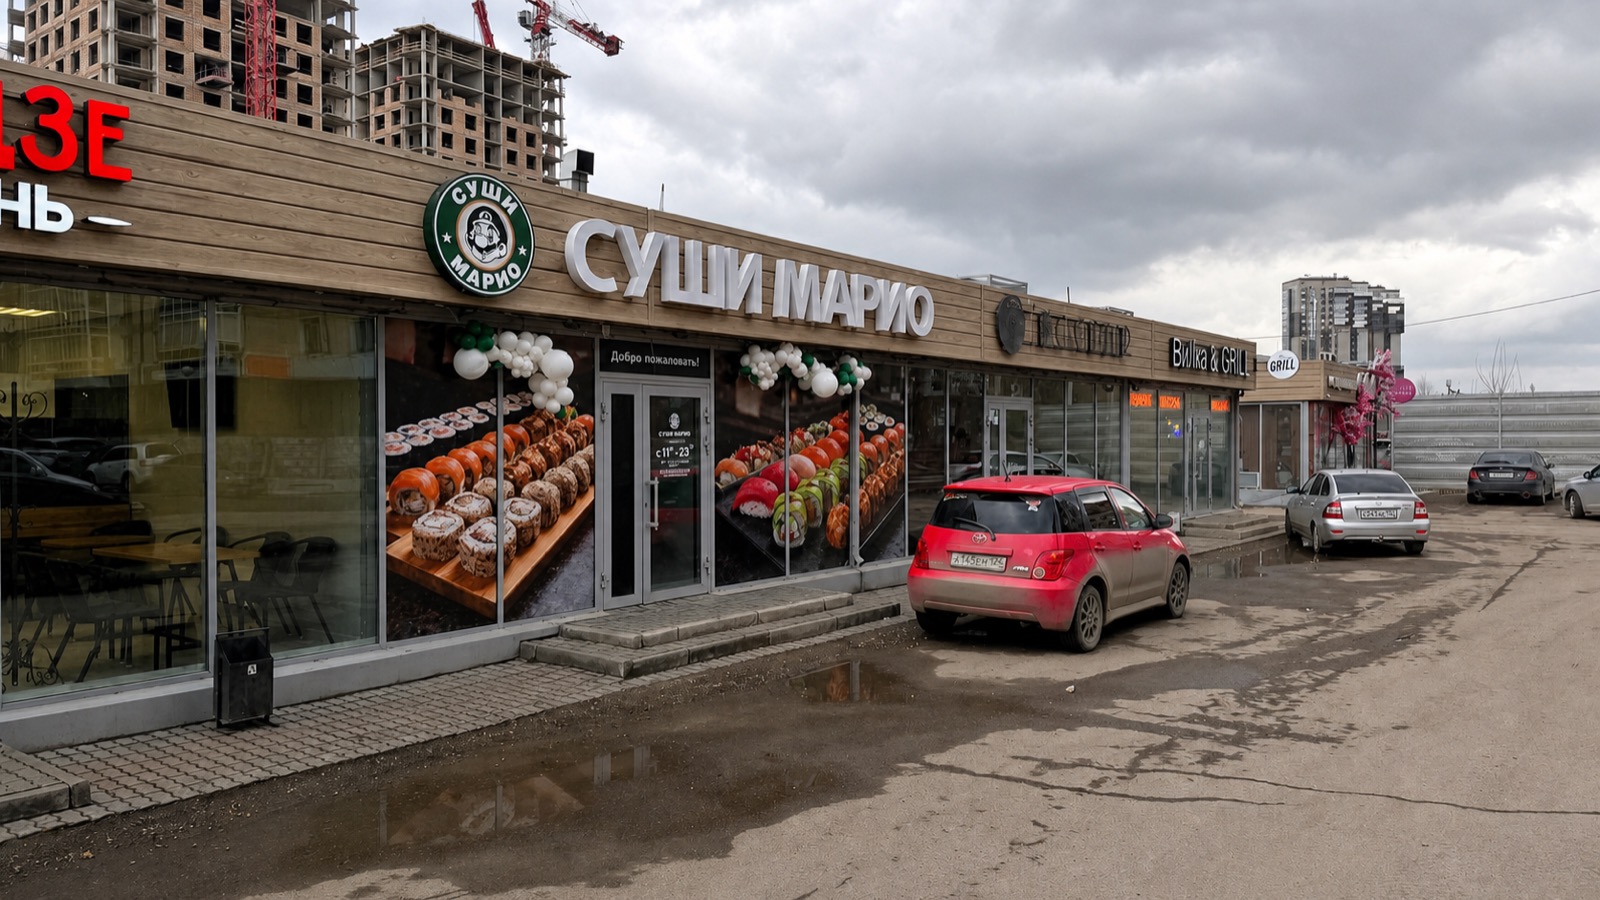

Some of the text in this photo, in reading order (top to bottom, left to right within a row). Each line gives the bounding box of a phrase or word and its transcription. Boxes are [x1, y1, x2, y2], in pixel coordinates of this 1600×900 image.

[452, 180, 519, 216] СУШИ
[450, 254, 521, 290] МАРИО
[564, 218, 763, 314] СУШИ
[772, 258, 935, 337] МАРИО
[611, 350, 700, 367] Добро пожаловать!
[1221, 346, 1250, 376] GRILL
[1270, 359, 1296, 372] GRILL
